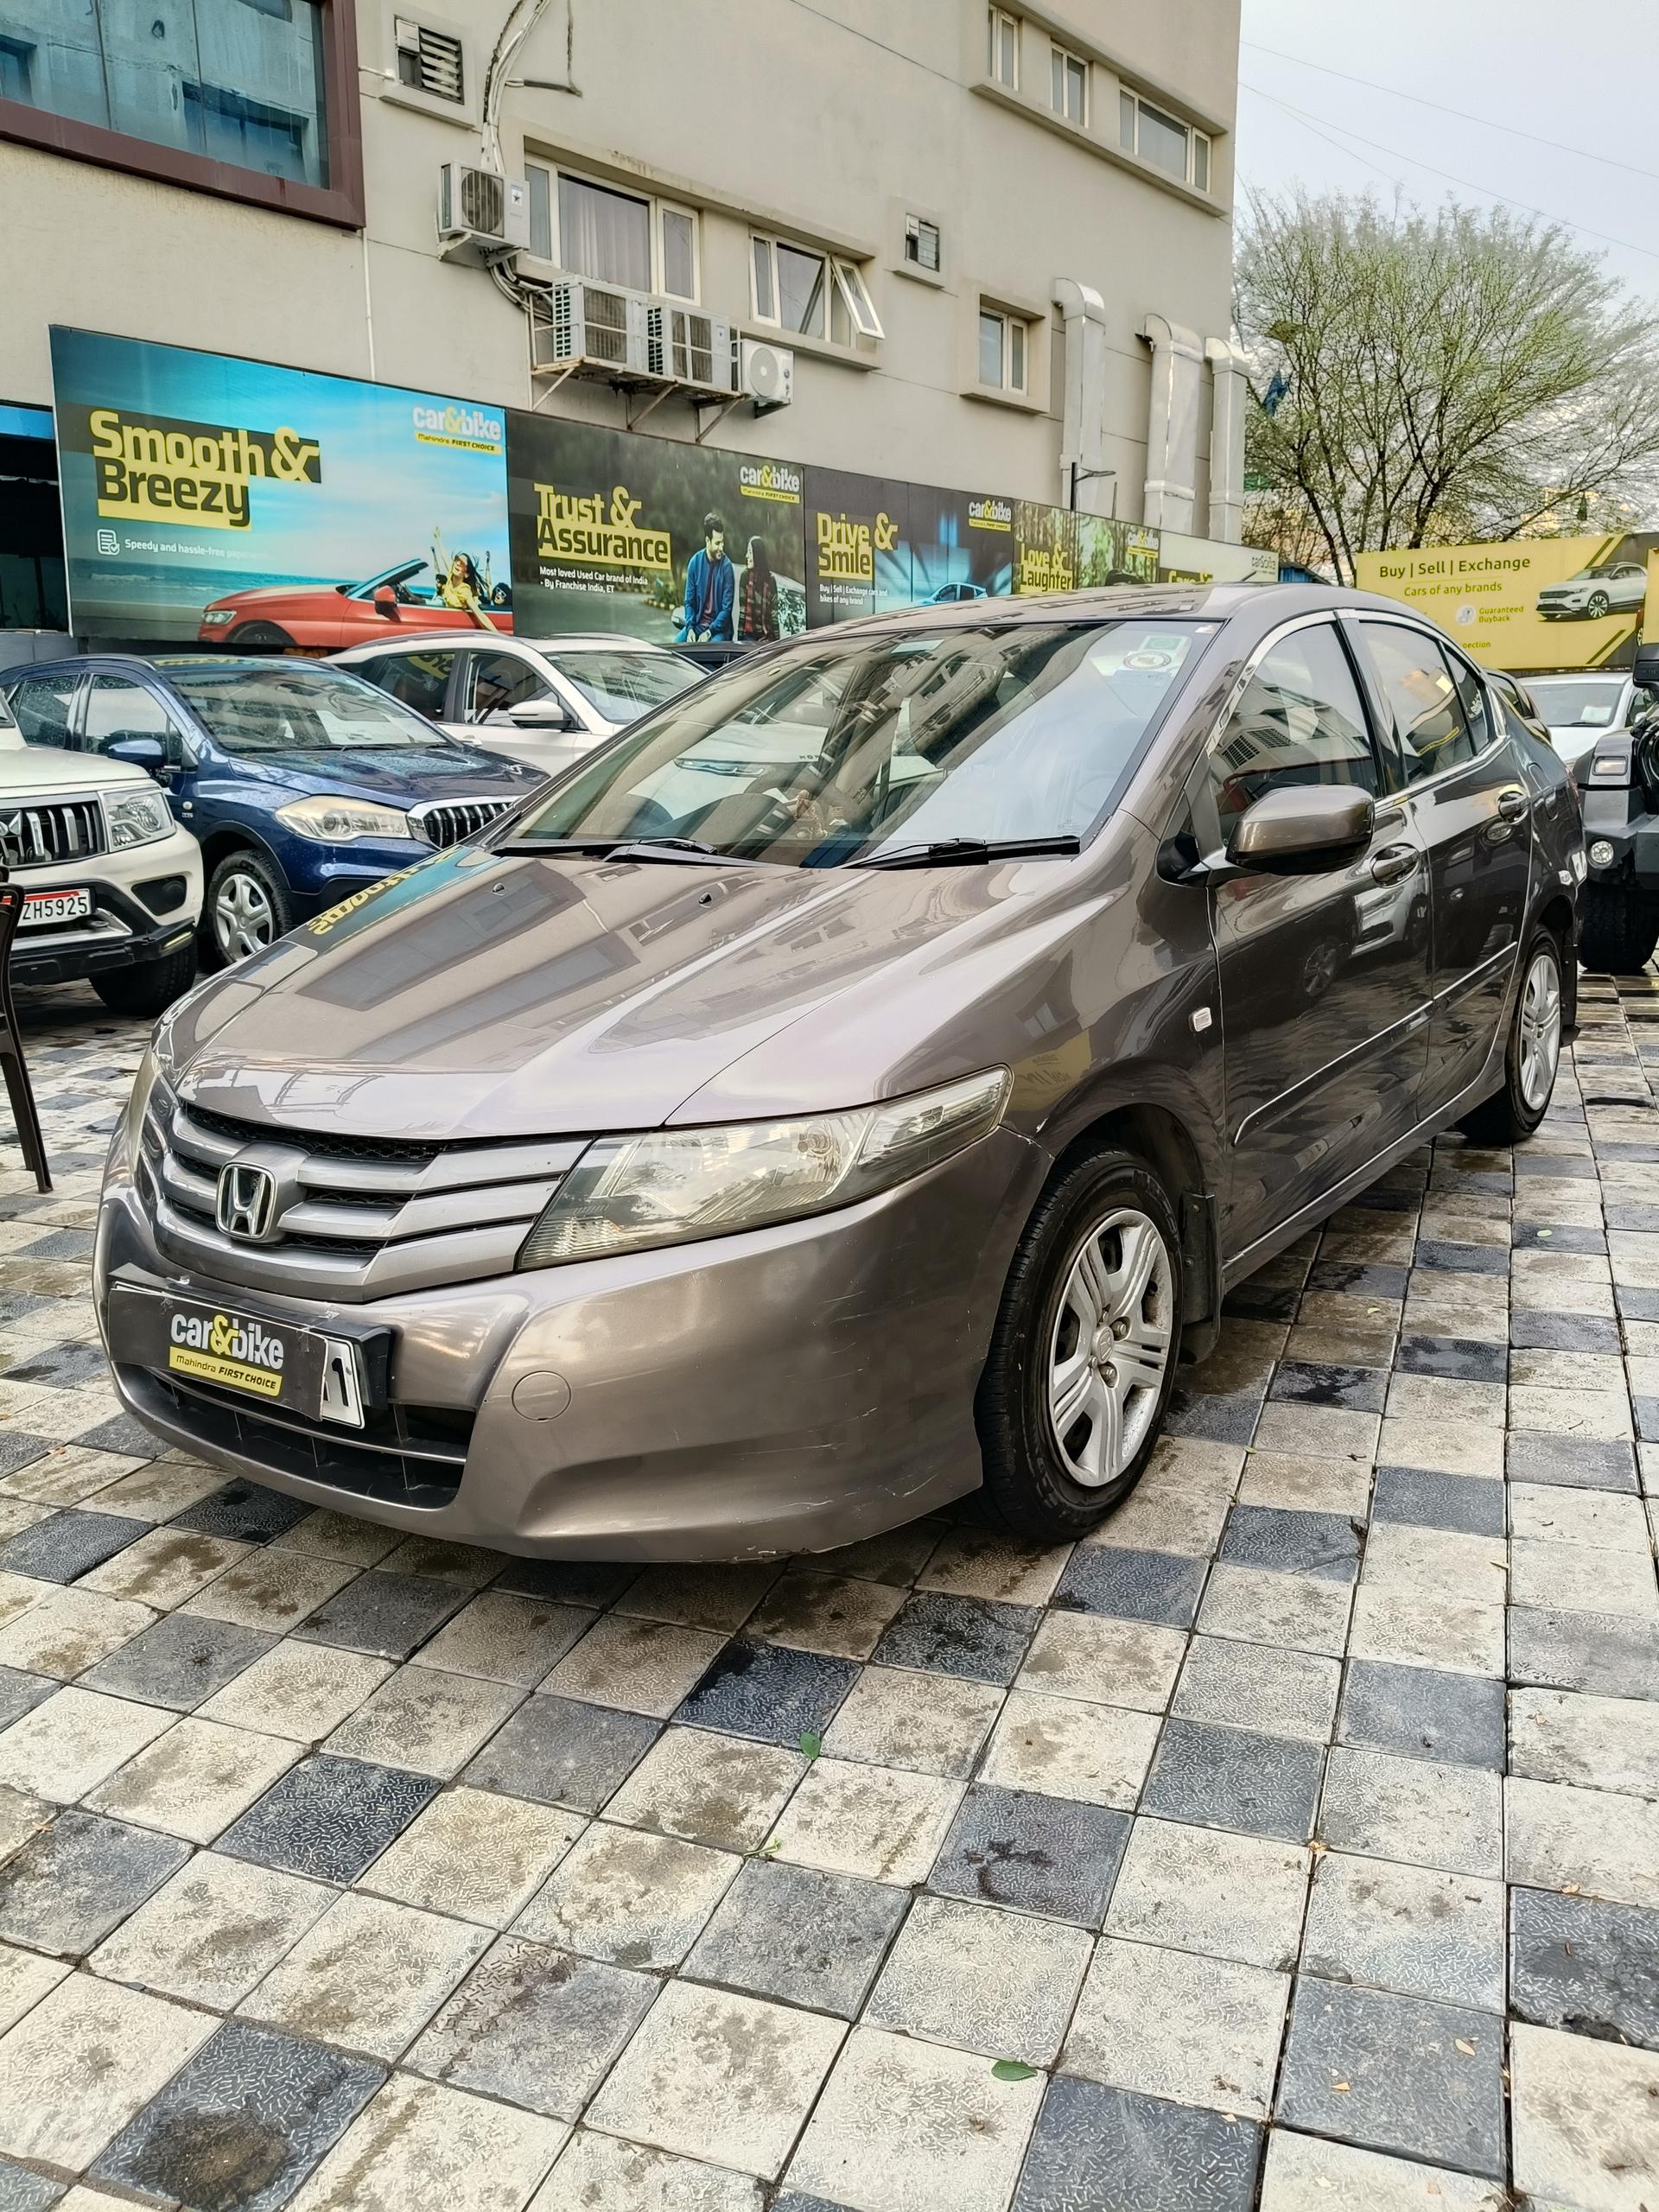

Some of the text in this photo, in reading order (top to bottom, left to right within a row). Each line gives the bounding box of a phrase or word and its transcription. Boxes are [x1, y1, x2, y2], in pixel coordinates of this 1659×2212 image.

[413, 405, 501, 441] car&bike
[90, 410, 320, 484] Smooth &
[471, 442, 495, 451] CHOICE
[95, 456, 251, 527] Breezy
[740, 465, 799, 492] car&bike
[534, 482, 642, 529] Trust &
[538, 518, 668, 563] Assurance
[817, 512, 899, 550] Drive &
[124, 538, 159, 553] Speedy
[160, 543, 176, 553] and
[178, 543, 226, 557] hassle-free
[818, 543, 870, 575] Smile
[1020, 543, 1068, 570] Love &
[539, 566, 648, 585] Most loved Used Car brand of India
[1020, 564, 1071, 592] Laughter
[1379, 566, 1406, 579] Buy
[1418, 561, 1446, 575] Sell
[1459, 558, 1530, 572] Exchange
[544, 578, 554, 589] By
[555, 580, 587, 591] Franchise
[607, 584, 615, 594] ET
[819, 583, 830, 594] Buy
[833, 585, 842, 594] Sell
[846, 586, 868, 596] Exchange
[1404, 582, 1503, 597] Cars of any brands
[1478, 606, 1524, 615] Guaranteed
[1478, 615, 1510, 624] Buyback
[170, 1313, 284, 1370] car&bike
[176, 1355, 276, 1389] Mahindra FIRST CHOICE
